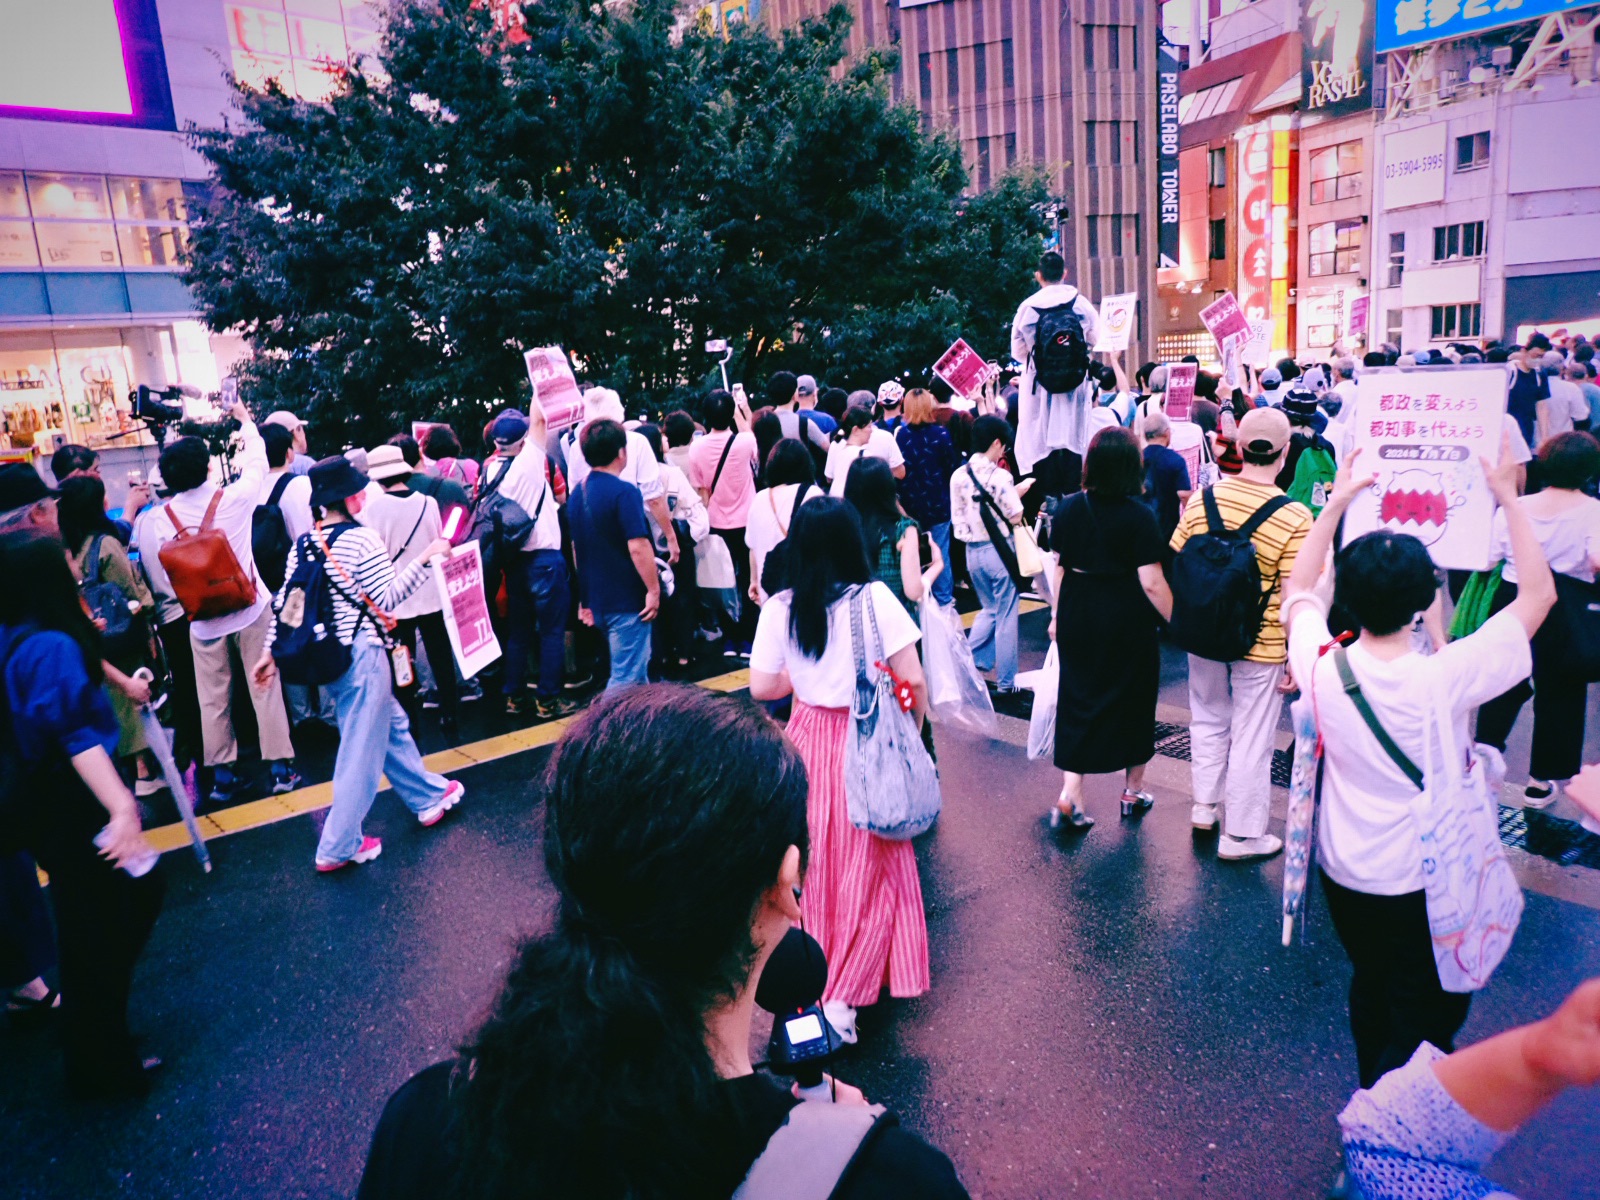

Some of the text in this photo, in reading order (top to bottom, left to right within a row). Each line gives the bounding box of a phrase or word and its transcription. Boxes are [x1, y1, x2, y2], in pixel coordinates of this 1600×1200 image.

[1160, 72, 1178, 224] PASELABO TOWER
[1385, 153, 1443, 179] 03-5904-5995
[1379, 394, 1478, 411] 都政を変えよう
[1370, 420, 1485, 438] 都知事を代えよう
[1384, 445, 1461, 460] 2024年7月7日
